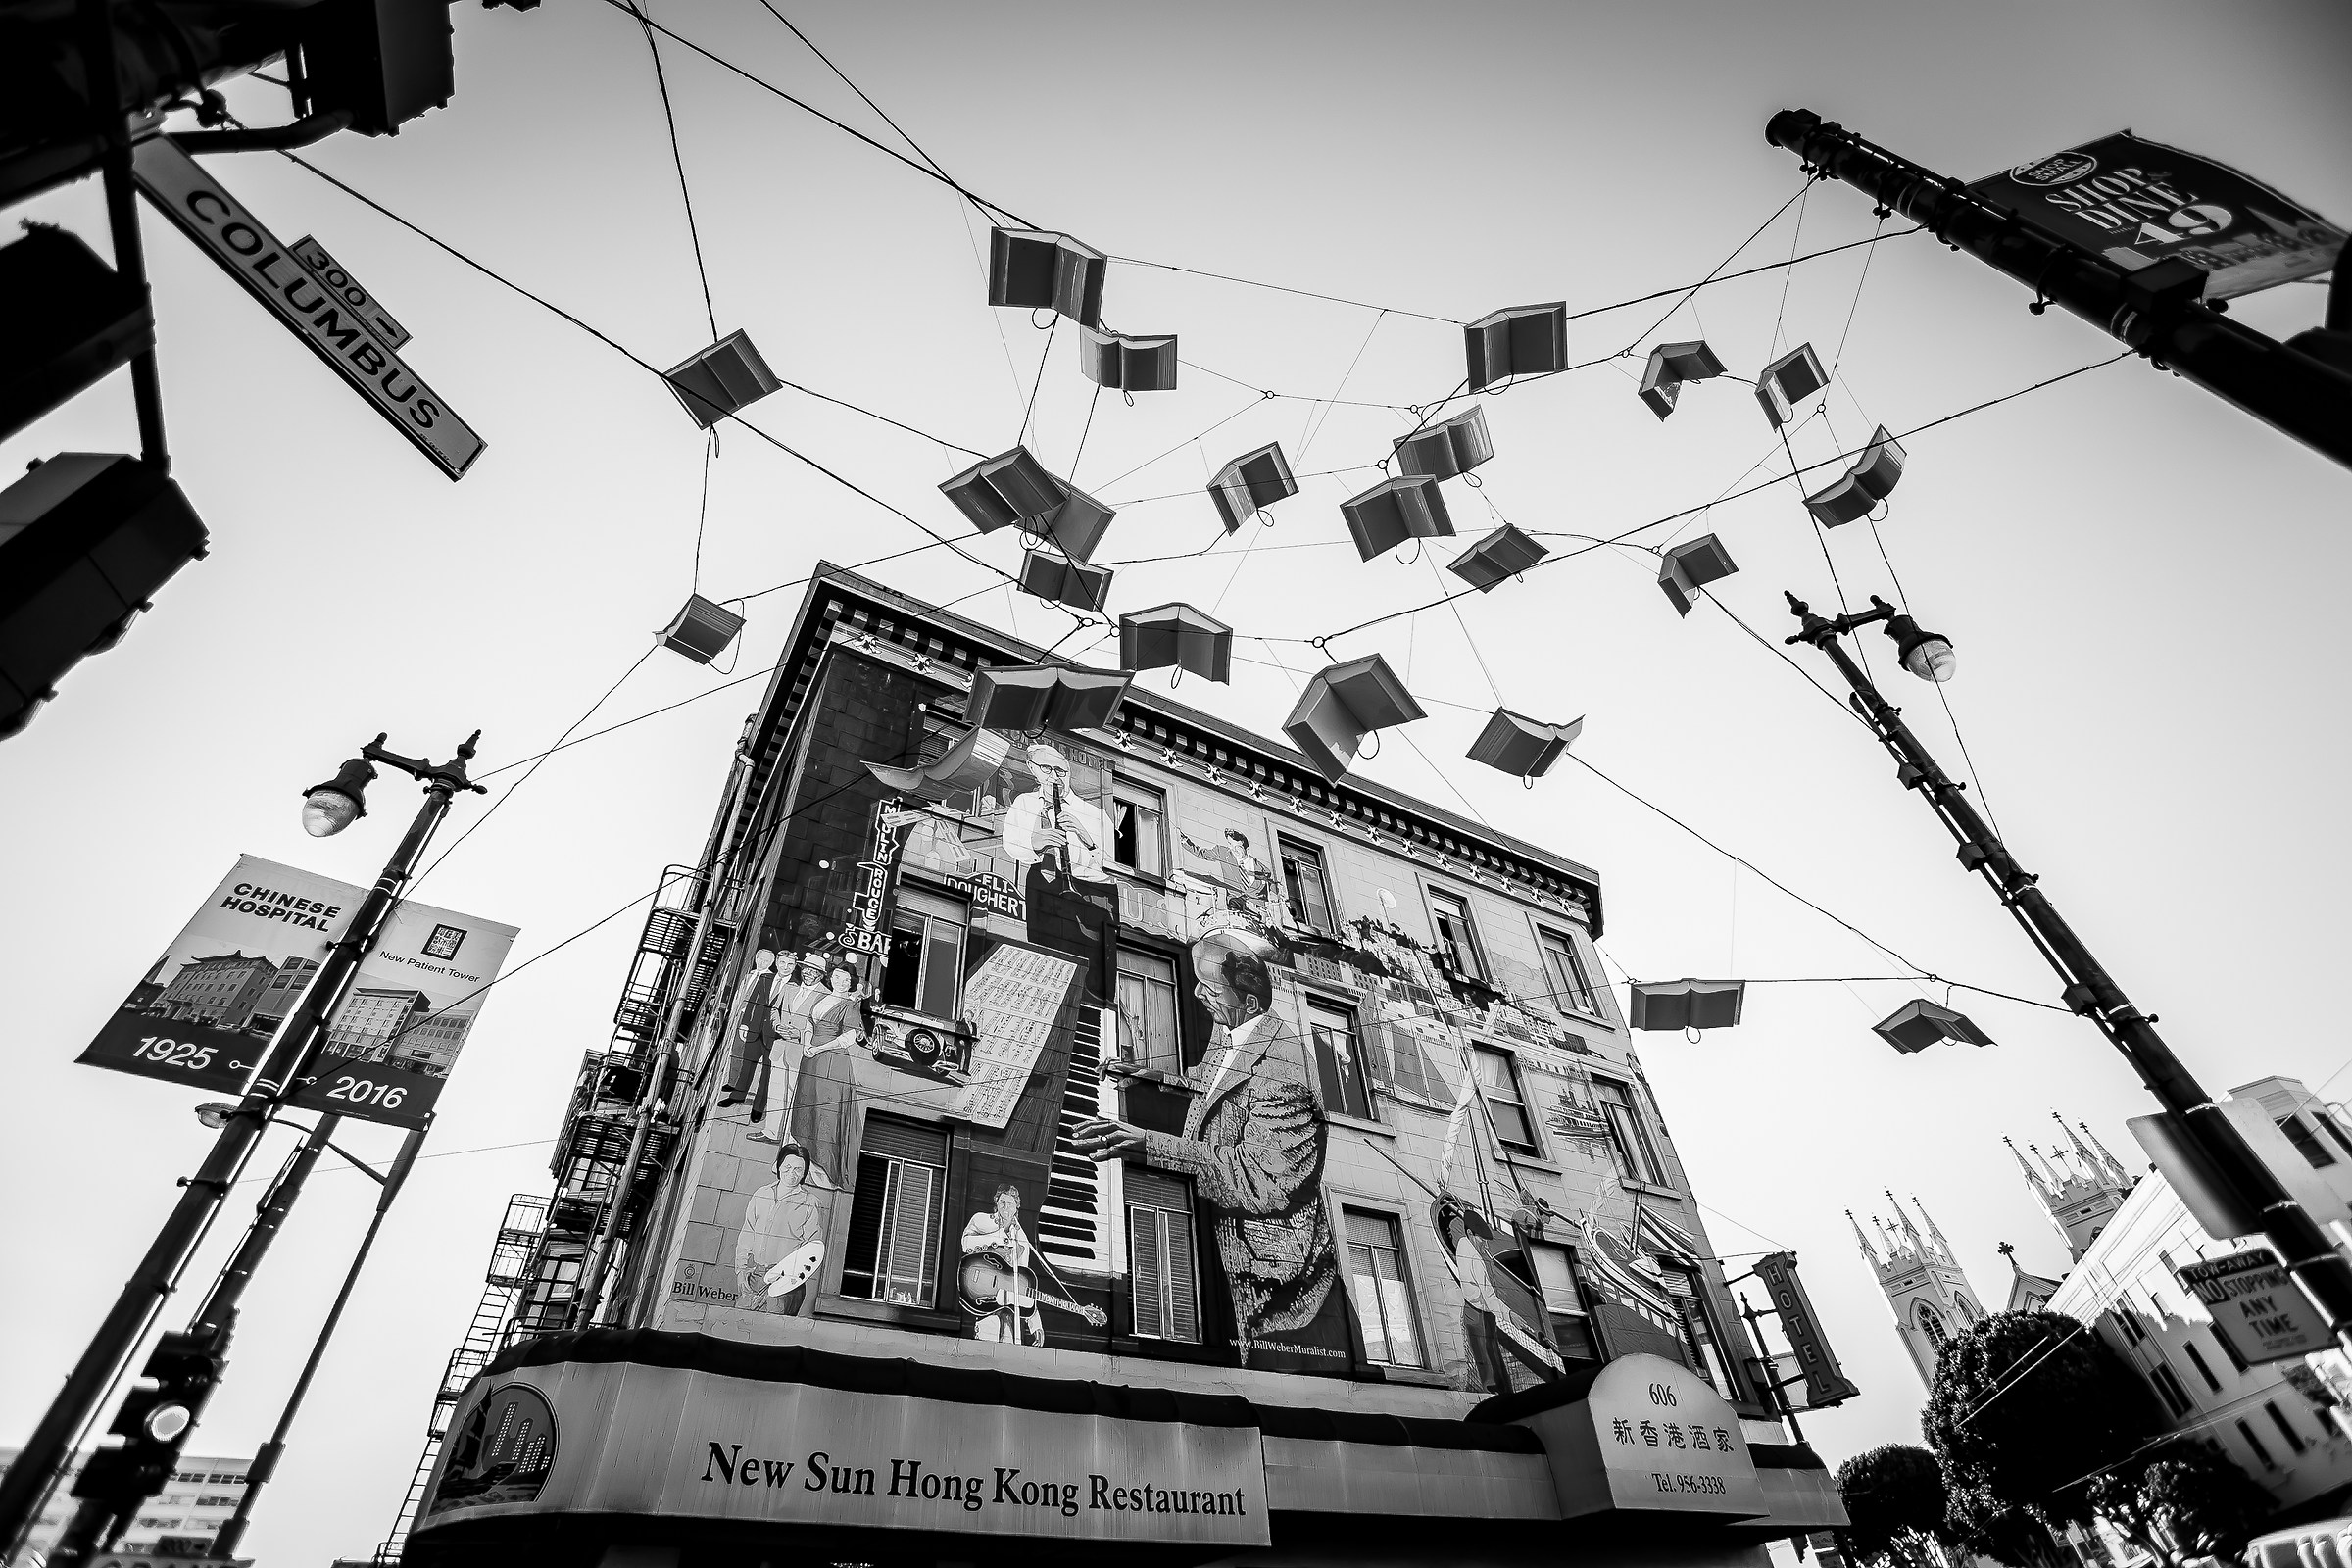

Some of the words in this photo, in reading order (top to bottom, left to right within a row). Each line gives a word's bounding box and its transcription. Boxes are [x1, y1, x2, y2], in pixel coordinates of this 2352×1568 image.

[2028, 159, 2064, 177] SHOP
[2035, 160, 2083, 181] SMALL
[2045, 168, 2147, 212] SHOP
[2075, 181, 2199, 229] DINE
[2134, 204, 2232, 245] 49
[306, 251, 367, 307] 300
[186, 190, 442, 429] COLUMBUS
[220, 896, 329, 932] HOSPITAL
[233, 883, 342, 918] CHINESE
[379, 951, 406, 963] New
[407, 957, 446, 974] Patient
[448, 968, 480, 982] Tower
[132, 1036, 219, 1070] 1925
[326, 1076, 408, 1109] 2016
[2187, 1252, 2265, 1279] TOW-AWAY
[672, 1282, 695, 1295] Bill
[699, 1285, 738, 1301] Weber
[2192, 1279, 2225, 1303] NO
[2239, 1295, 2277, 1319] ANY
[1765, 1262, 1831, 1394] HOTEL
[2248, 1313, 2299, 1339] TIME
[1229, 1338, 1347, 1358] www.BillWeberMuralist.com
[1648, 1382, 1677, 1406] 606
[1612, 1417, 1735, 1452] 新香港酒家
[701, 1441, 795, 1489] New
[804, 1451, 875, 1495] Sun
[887, 1458, 984, 1512] Hong
[992, 1467, 1079, 1517] Kong
[1088, 1473, 1246, 1516] Restaurant
[1651, 1473, 1677, 1492] Tel.
[1677, 1474, 1727, 1494] 956-3338
